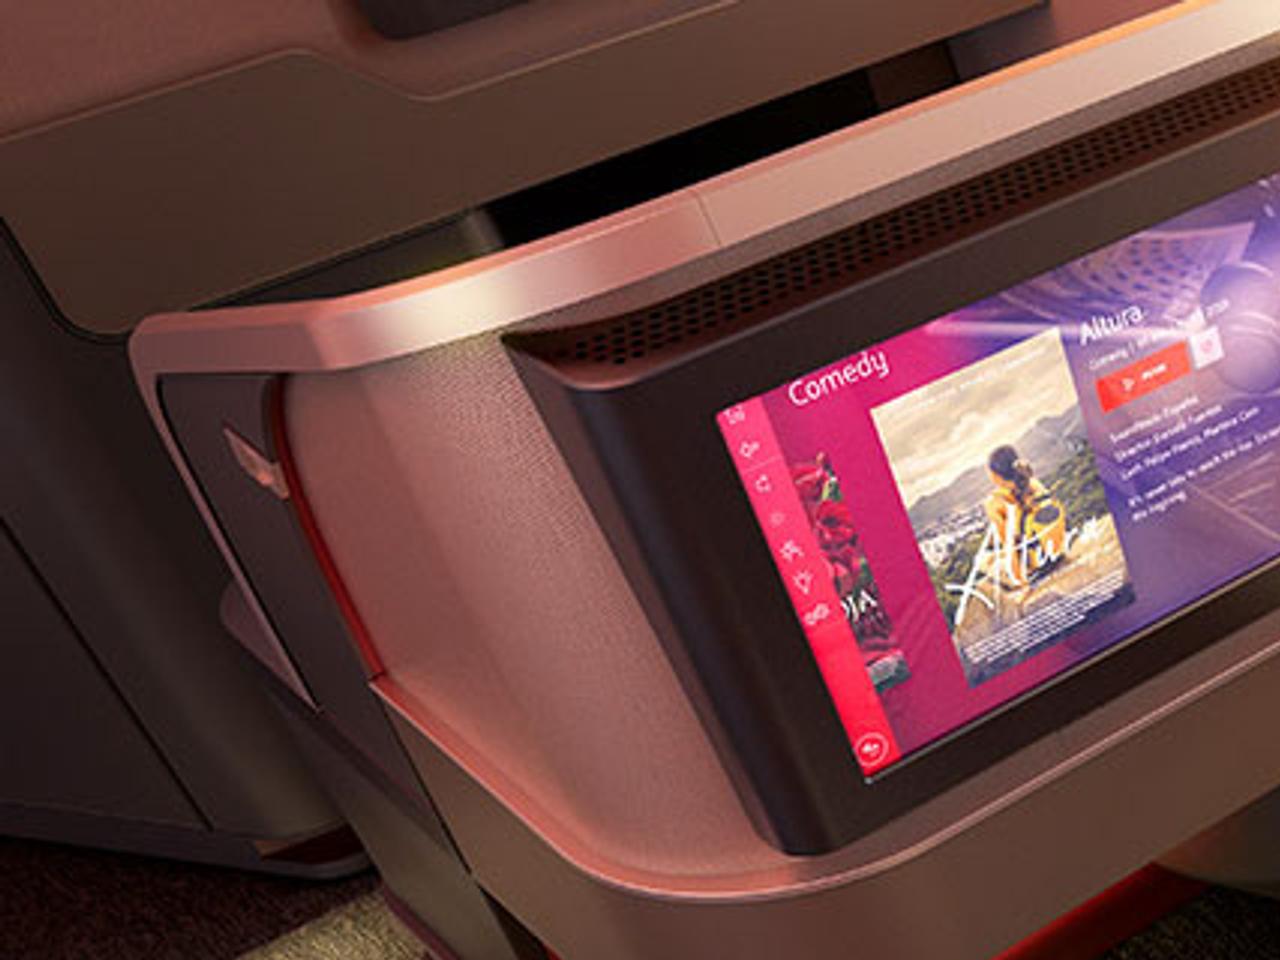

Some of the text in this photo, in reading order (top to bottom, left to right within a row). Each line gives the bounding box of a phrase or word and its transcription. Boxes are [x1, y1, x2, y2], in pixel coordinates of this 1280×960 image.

[1080, 305, 1143, 346] Altura
[788, 349, 890, 406] Comedy
[944, 502, 1100, 626] Altura
